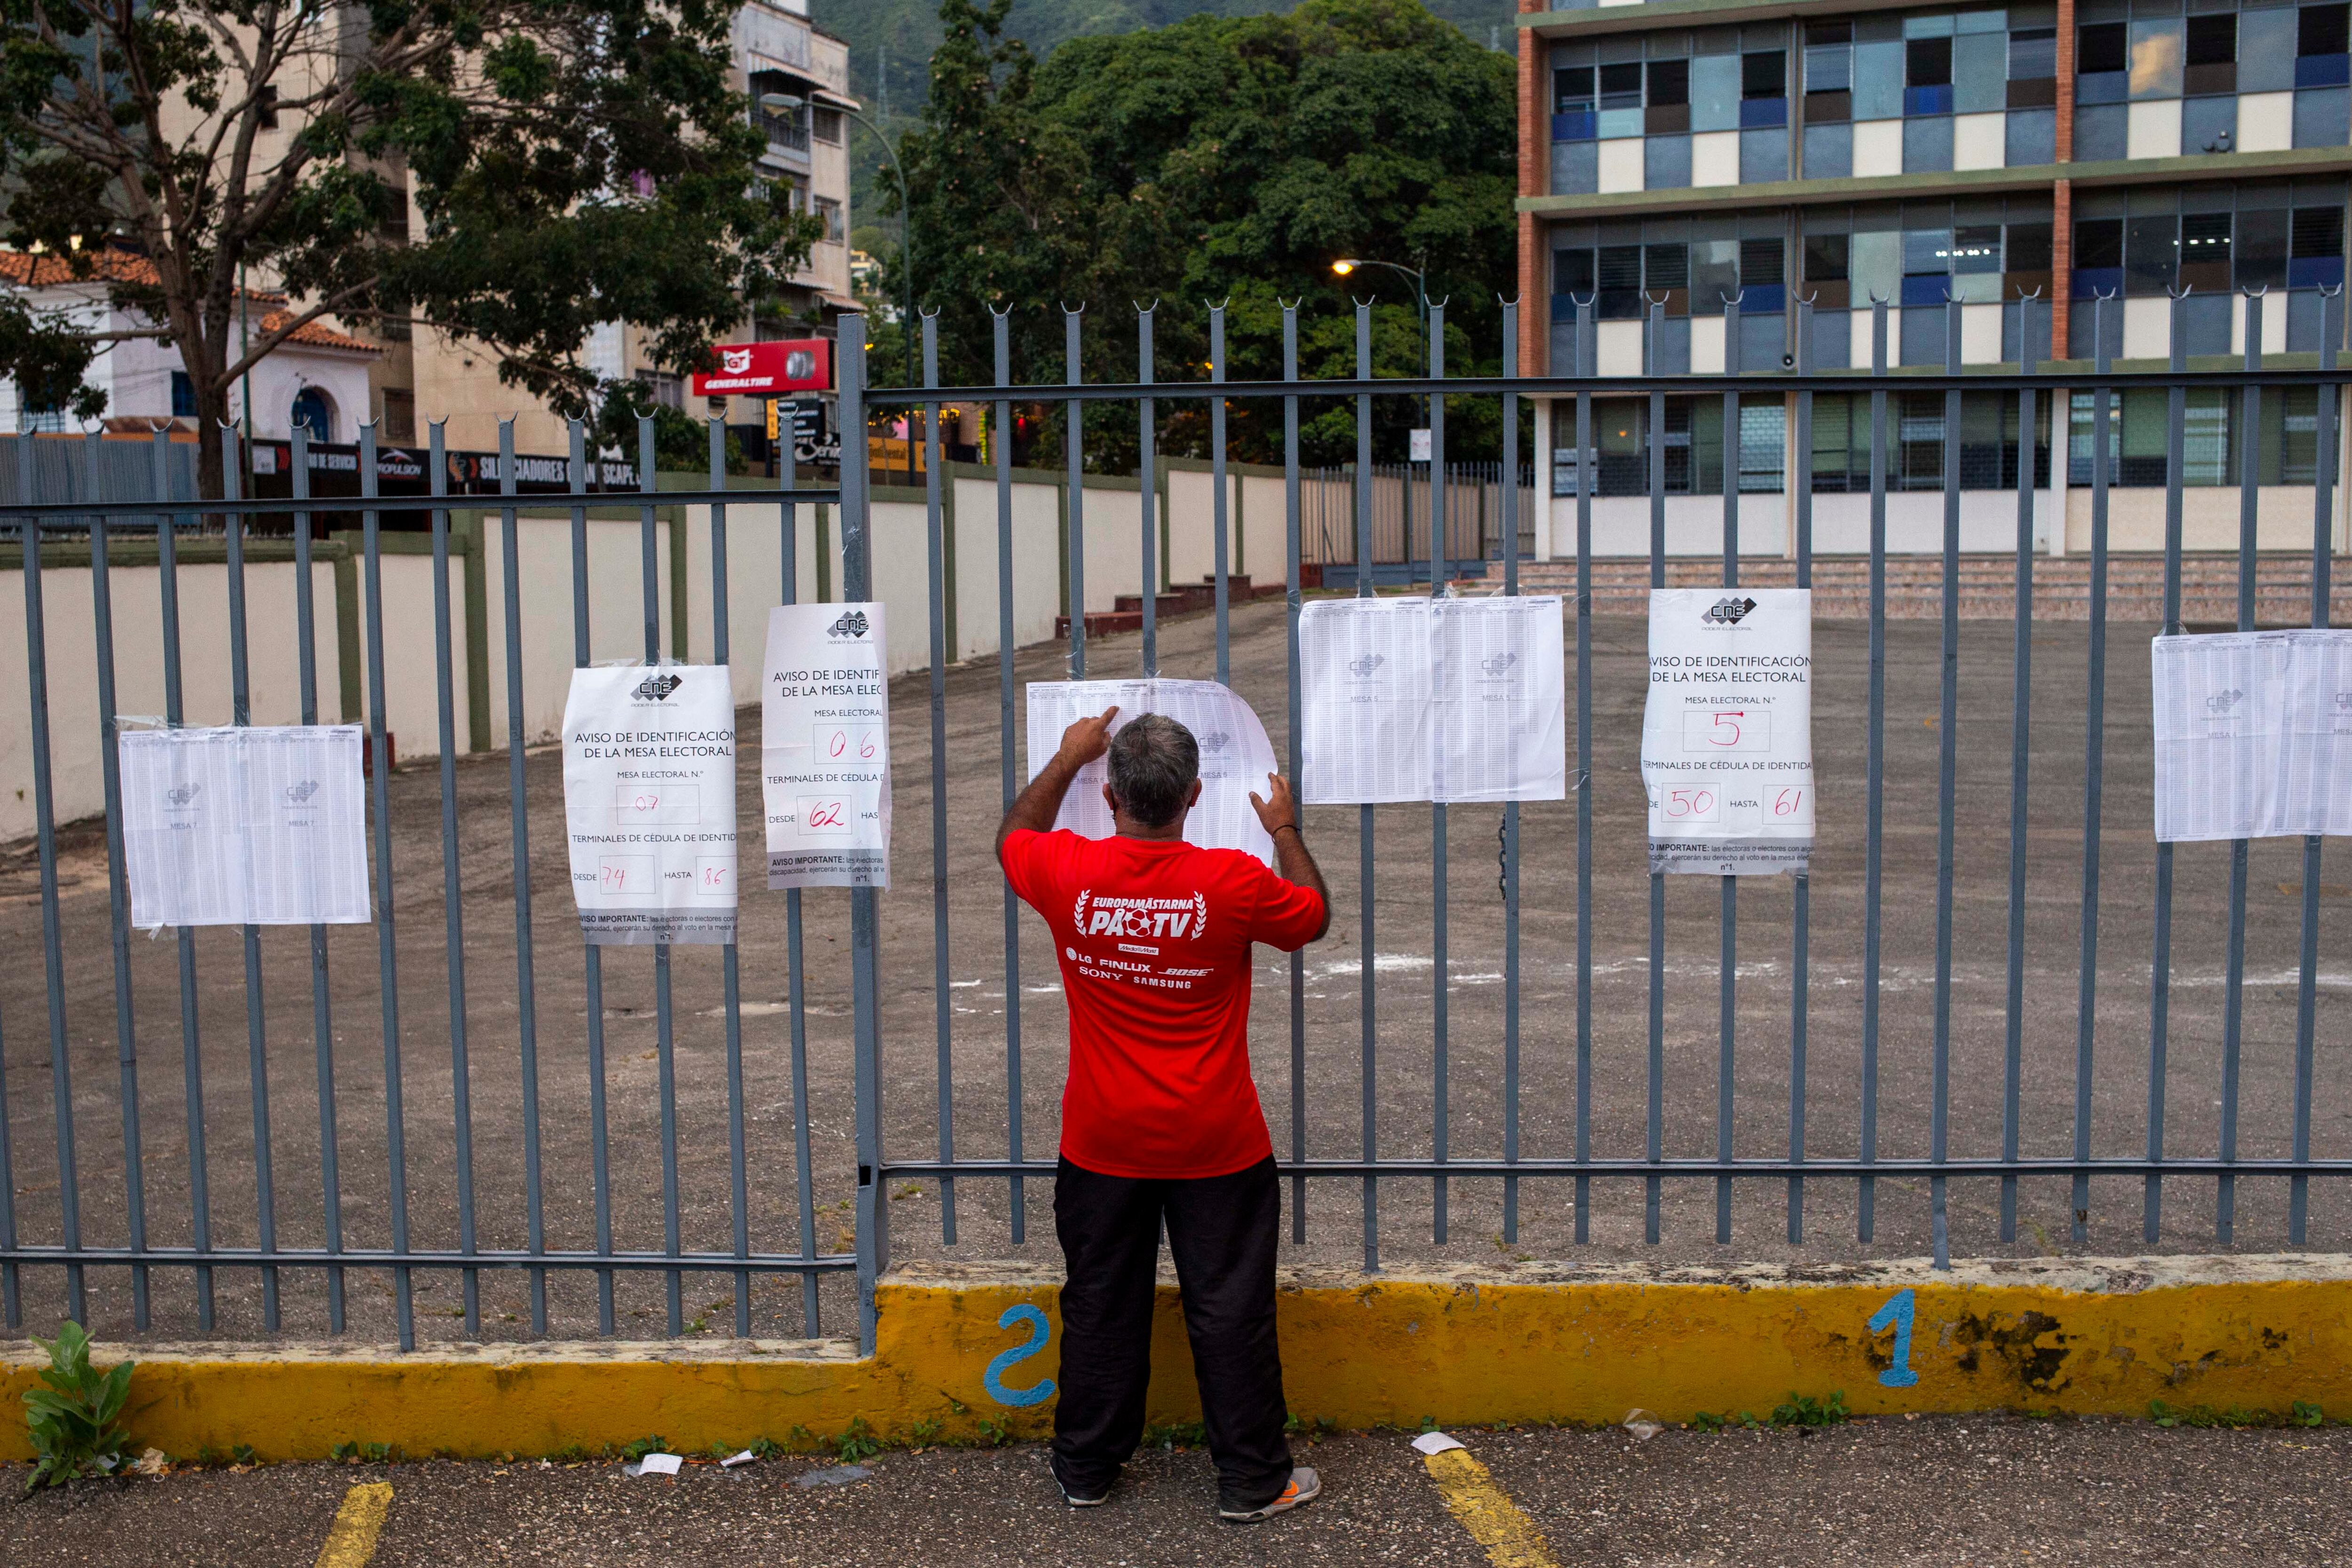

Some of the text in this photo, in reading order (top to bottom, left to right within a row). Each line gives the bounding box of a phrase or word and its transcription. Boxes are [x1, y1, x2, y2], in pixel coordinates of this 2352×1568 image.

[1710, 605, 1746, 618] CNE
[836, 618, 869, 631] CNE
[1685, 657, 1702, 667] DE
[774, 671, 808, 682] AVISO
[813, 670, 829, 680] DE
[1653, 672, 1806, 682] DE LA MESA ELECTORAL
[639, 681, 673, 694] CNE
[783, 687, 798, 697] DE
[803, 686, 818, 696] LA
[822, 685, 853, 695] MESA
[1708, 711, 1744, 745] 5
[575, 733, 611, 743] AVISO
[616, 732, 633, 742] DE
[585, 746, 732, 758] DE LA MESA ELECTORAL
[1710, 760, 1749, 769] CÉDULA
[767, 775, 823, 784] TERMINALES
[841, 772, 878, 781] CÉDULA
[635, 795, 658, 811] 07
[1667, 790, 1713, 816] 50
[1775, 788, 1801, 816] 61
[810, 801, 844, 827] 62
[644, 833, 681, 842] CÉDULA
[772, 858, 793, 866] AVISO
[795, 856, 845, 864] IMPORTANTE:
[602, 866, 625, 889] 74
[705, 868, 726, 885] 86
[769, 867, 807, 876] discapacidad,
[1152, 913, 1192, 937] TV
[1079, 953, 1212, 976] LG FINLUX BOSE
[1079, 966, 1191, 989] SONY SAMSUNG
[1868, 1288, 1918, 1387] 1
[984, 1304, 1056, 1407] 2
